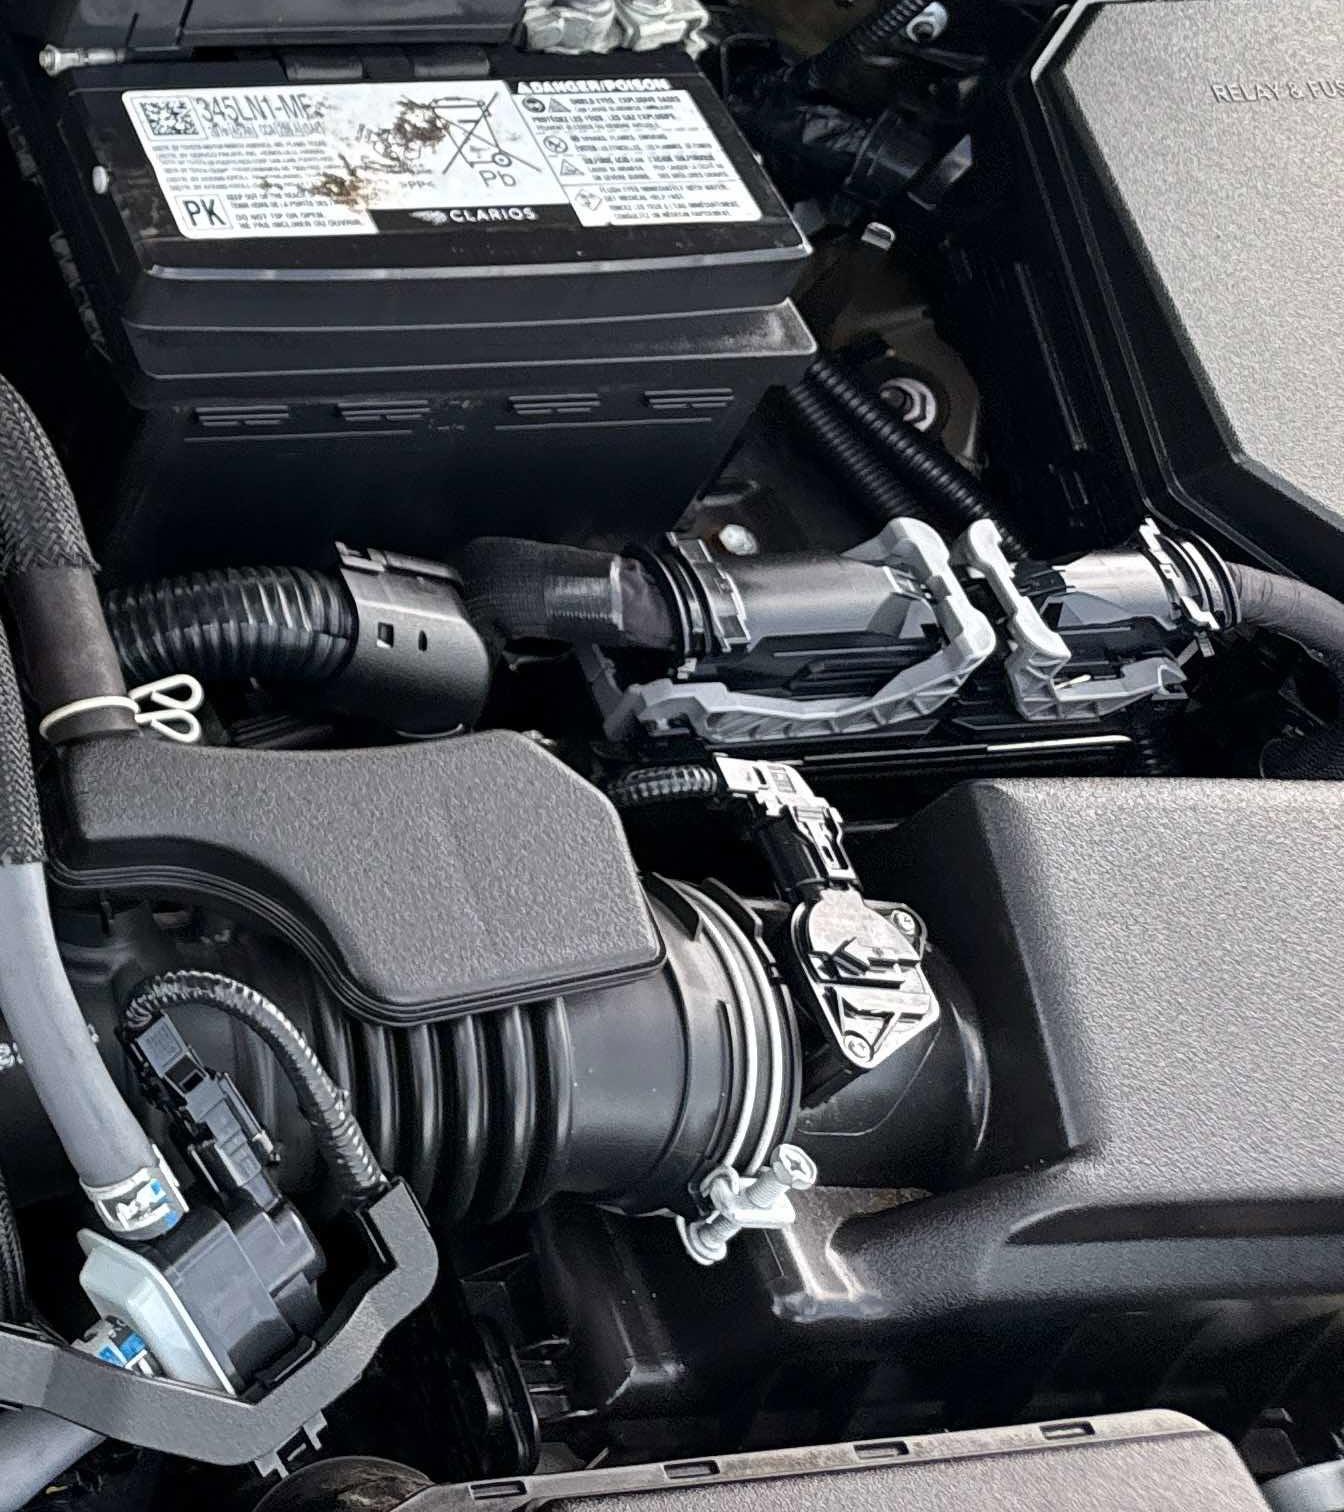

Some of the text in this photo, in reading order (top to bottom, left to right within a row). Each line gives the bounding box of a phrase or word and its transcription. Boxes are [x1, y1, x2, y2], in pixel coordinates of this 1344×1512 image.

[1210, 82, 1280, 104] RELAY
[1287, 81, 1305, 101] &
[478, 169, 517, 188] Pb
[183, 199, 227, 227] PK
[449, 207, 539, 223] CLARIOS
